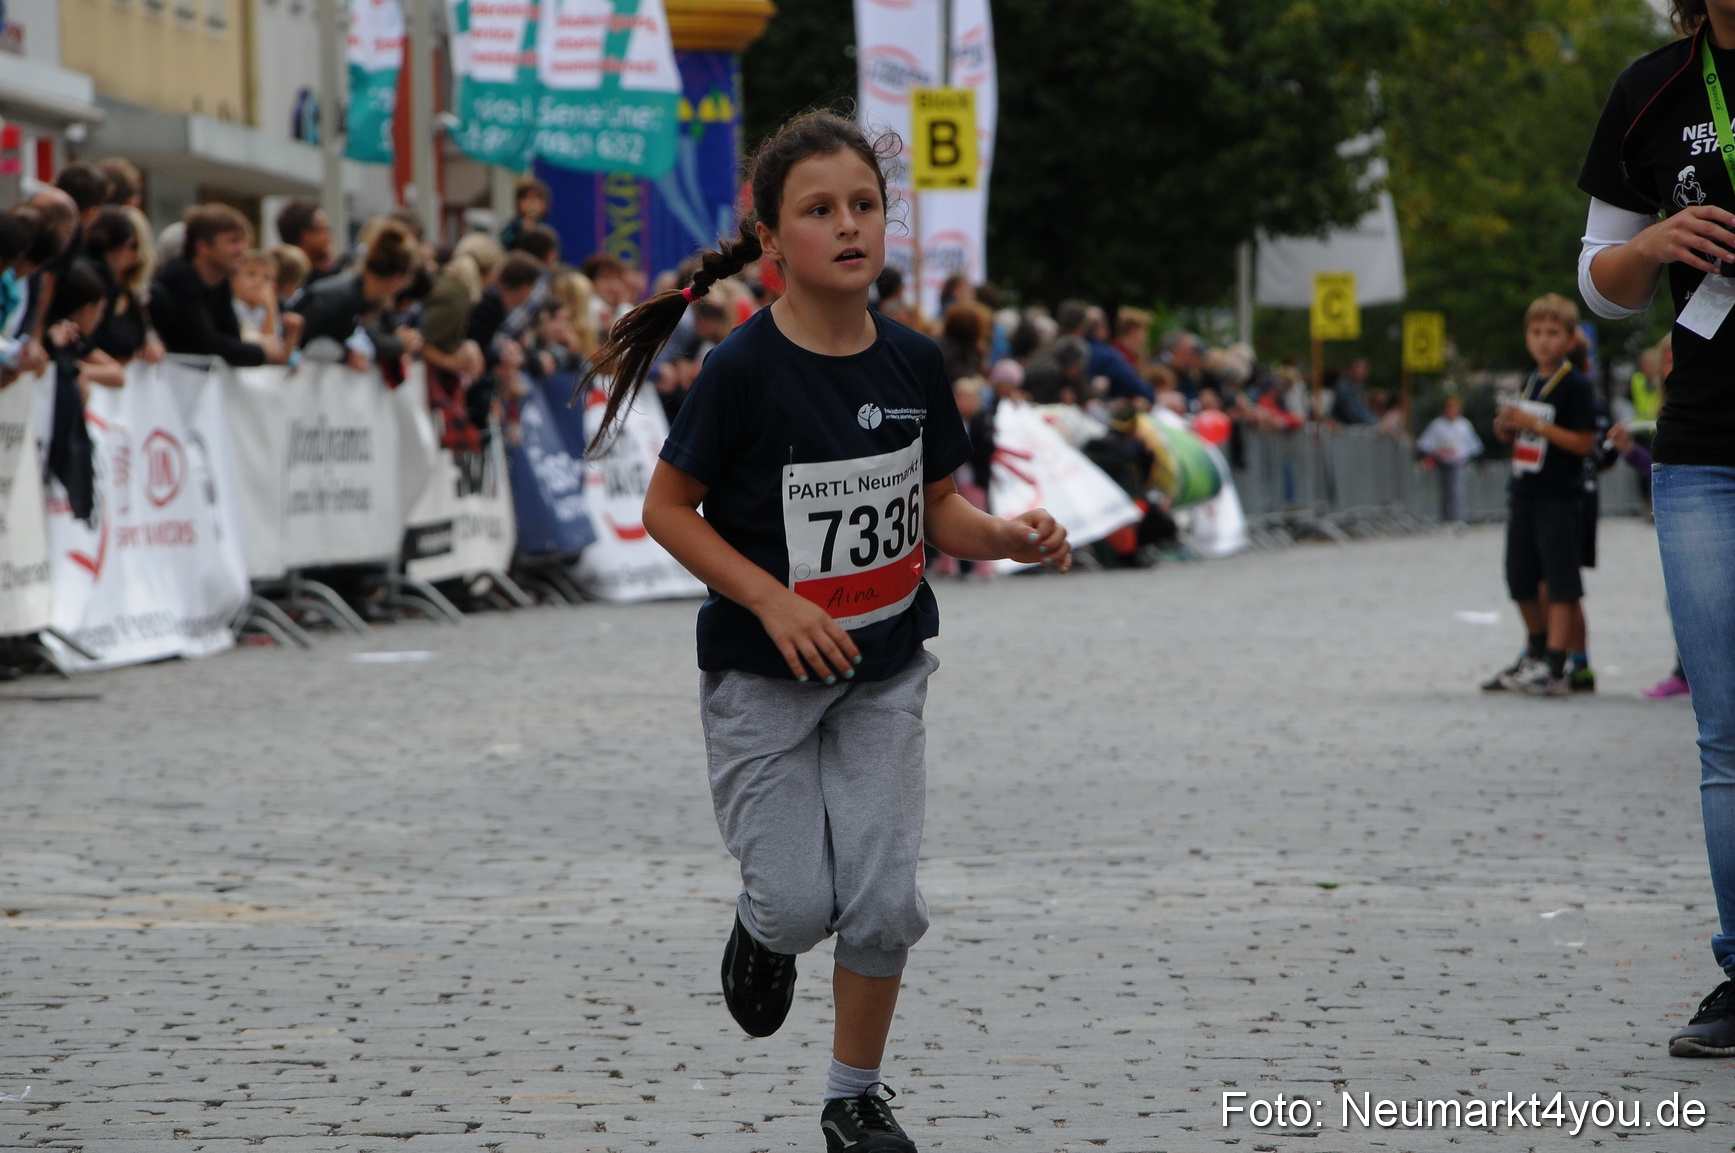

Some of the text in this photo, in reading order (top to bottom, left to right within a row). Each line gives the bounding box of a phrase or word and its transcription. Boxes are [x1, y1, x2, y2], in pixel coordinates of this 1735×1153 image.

[929, 120, 961, 167] B
[1321, 286, 1347, 319] C
[788, 458, 919, 500] PARTL Neumarkt
[808, 484, 920, 574] 7336
[827, 587, 880, 608] Aina
